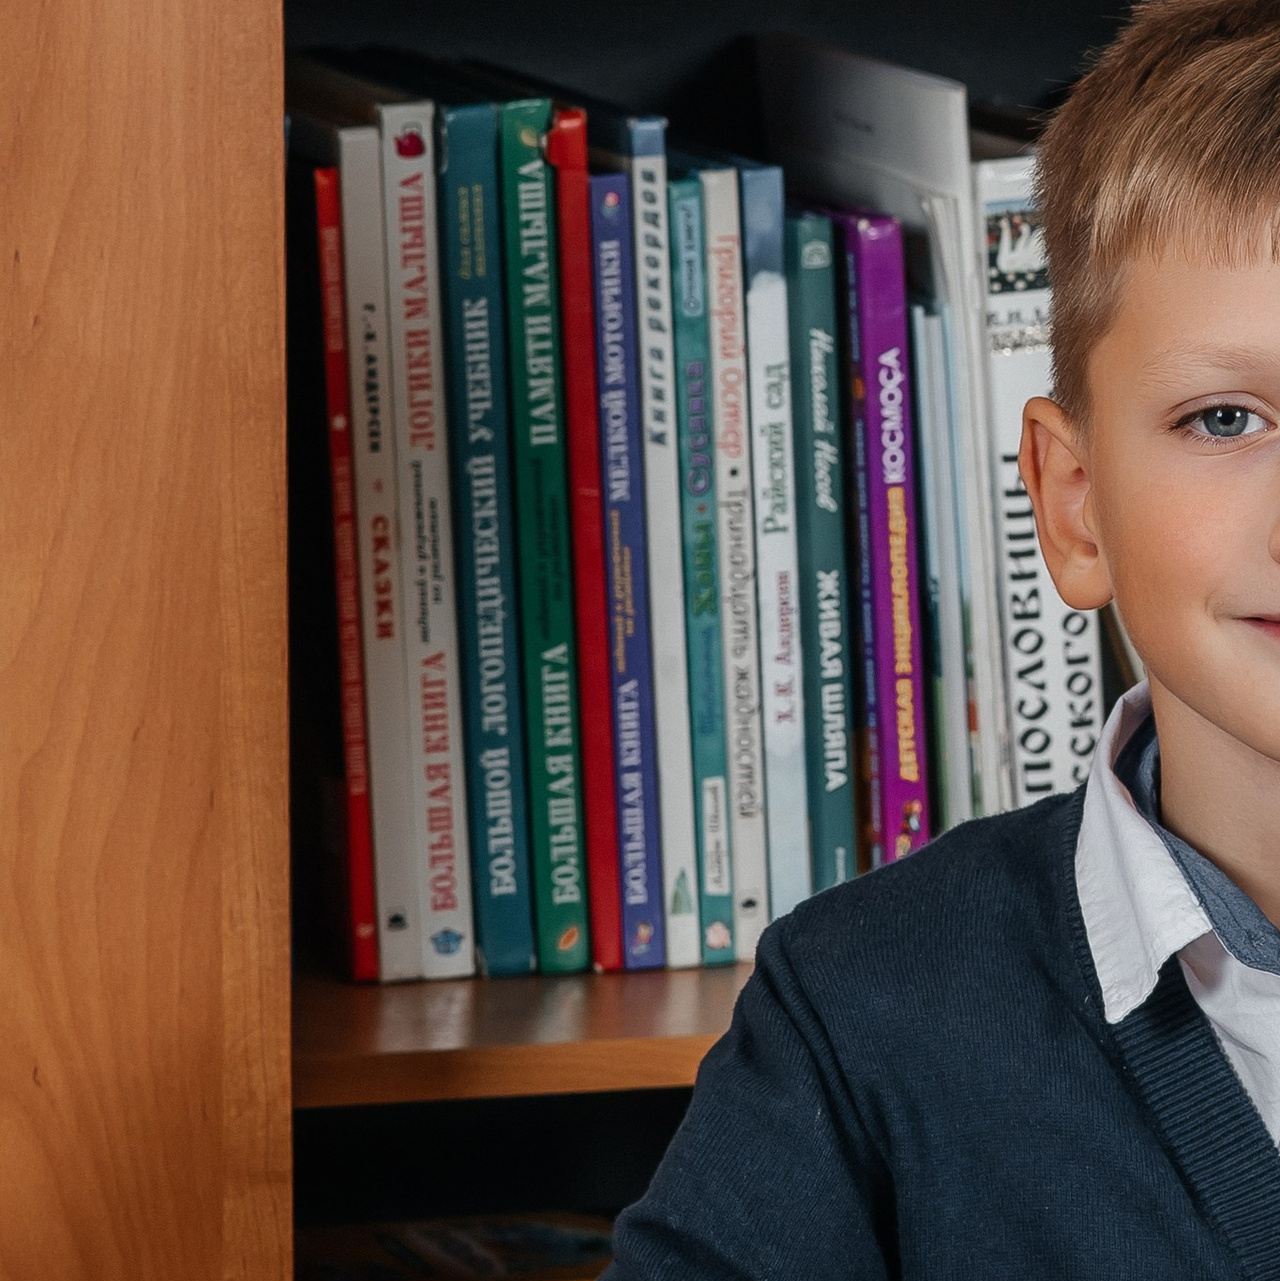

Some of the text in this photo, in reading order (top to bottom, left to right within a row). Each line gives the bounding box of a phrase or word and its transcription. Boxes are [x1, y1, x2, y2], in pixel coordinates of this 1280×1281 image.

[516, 159, 549, 308] МАЛЫША
[639, 168, 668, 447] Книга рекордов
[397, 170, 436, 453] ЛОГИКИ МАЛЫША
[524, 315, 557, 446] ПАМЯТИ
[599, 240, 627, 385] МОТОРИКИ
[707, 234, 746, 460] Григорий Остер
[600, 389, 631, 502] МЕЛКОЙ
[760, 360, 790, 535] Райский сад
[808, 326, 840, 515] Николай Носов
[877, 346, 907, 486] КОСМОСА
[462, 298, 517, 896] БОЛЬШОЙ ЛОГОПЕДИЧЕСКИЙ УЧЕБНИК
[540, 641, 571, 748] КНИГА
[616, 678, 641, 767] КНИГА
[817, 569, 848, 793] ЖИВАЯ ШЛЯПА
[419, 650, 459, 913] БОЛЬШАЯ КНИГА
[545, 754, 581, 906] БОЛЬШАЯ
[617, 771, 648, 906] БОЛЬШАЯ
